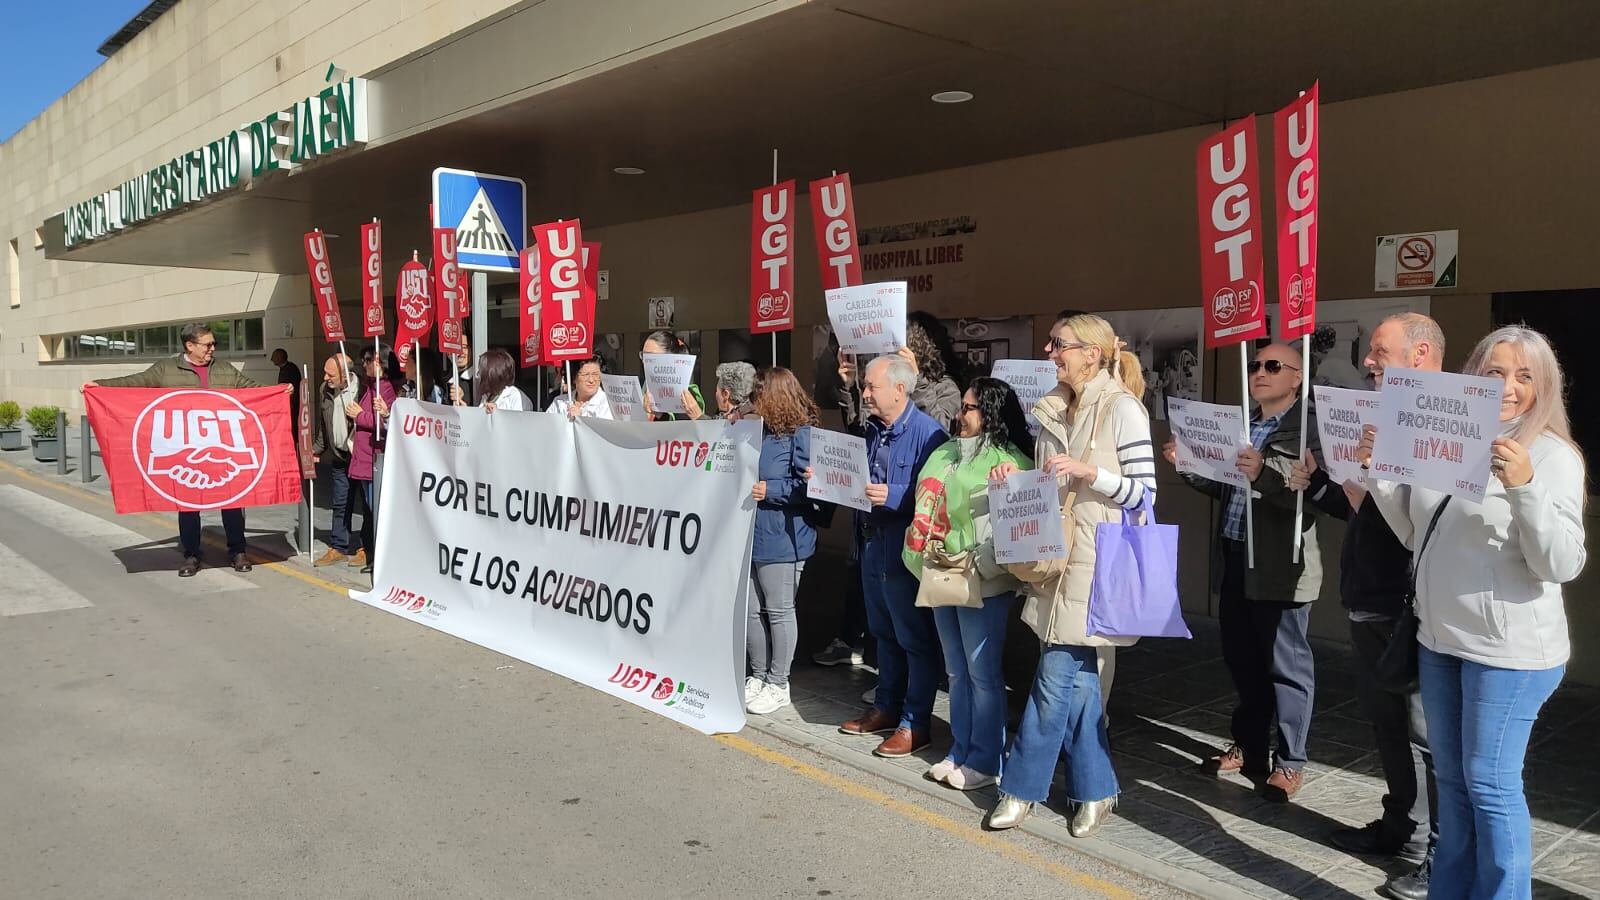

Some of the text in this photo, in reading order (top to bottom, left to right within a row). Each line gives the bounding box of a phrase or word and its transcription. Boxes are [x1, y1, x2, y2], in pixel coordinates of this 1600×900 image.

[64, 62, 360, 248] HOSPITAL UNIVERSITARIO DE JAÉN
[1288, 98, 1315, 268] UGT
[1210, 129, 1253, 283] UGT
[761, 188, 789, 291] UGT
[820, 182, 853, 289] UGT
[368, 226, 380, 304] UGT
[863, 243, 964, 271] HOSPITAL LIBRE
[309, 235, 333, 311] UGT
[402, 269, 427, 299] UGT
[441, 231, 458, 319] UGT
[547, 226, 581, 322] UGT
[527, 246, 543, 331] UGT
[1215, 292, 1236, 309] UGT
[838, 308, 893, 323] PROFESIONAL
[845, 299, 882, 311] CARRERA
[1005, 375, 1038, 386] CARRERA
[1387, 376, 1404, 387] UGT
[1463, 385, 1478, 396] UGT
[1329, 407, 1361, 425] CARRERA
[1415, 393, 1469, 417] CARRERA
[152, 409, 247, 456] UGT
[403, 414, 433, 439] UGT
[1185, 416, 1221, 431] CARRERA
[1323, 421, 1362, 441] PROFESION
[1397, 410, 1482, 441] PROFESIONAL
[1179, 426, 1234, 447] PROFESIONAL
[656, 439, 694, 468] UGT
[824, 445, 852, 460] CARRERA
[1413, 437, 1463, 464] ¡¡¡YA!!!
[816, 455, 860, 474] PROFESIONAL
[1375, 462, 1394, 472] UGT
[1006, 488, 1042, 504] CARRERA
[1455, 479, 1469, 489] UGT
[420, 471, 702, 555] POR EL CUMPLIMIENTO
[997, 502, 1048, 520] PROFESIONAL
[382, 586, 416, 607] UGT
[438, 543, 655, 635] DE LOS ACUERDOS
[608, 662, 658, 693] UGT
[686, 684, 710, 700] Servicios
